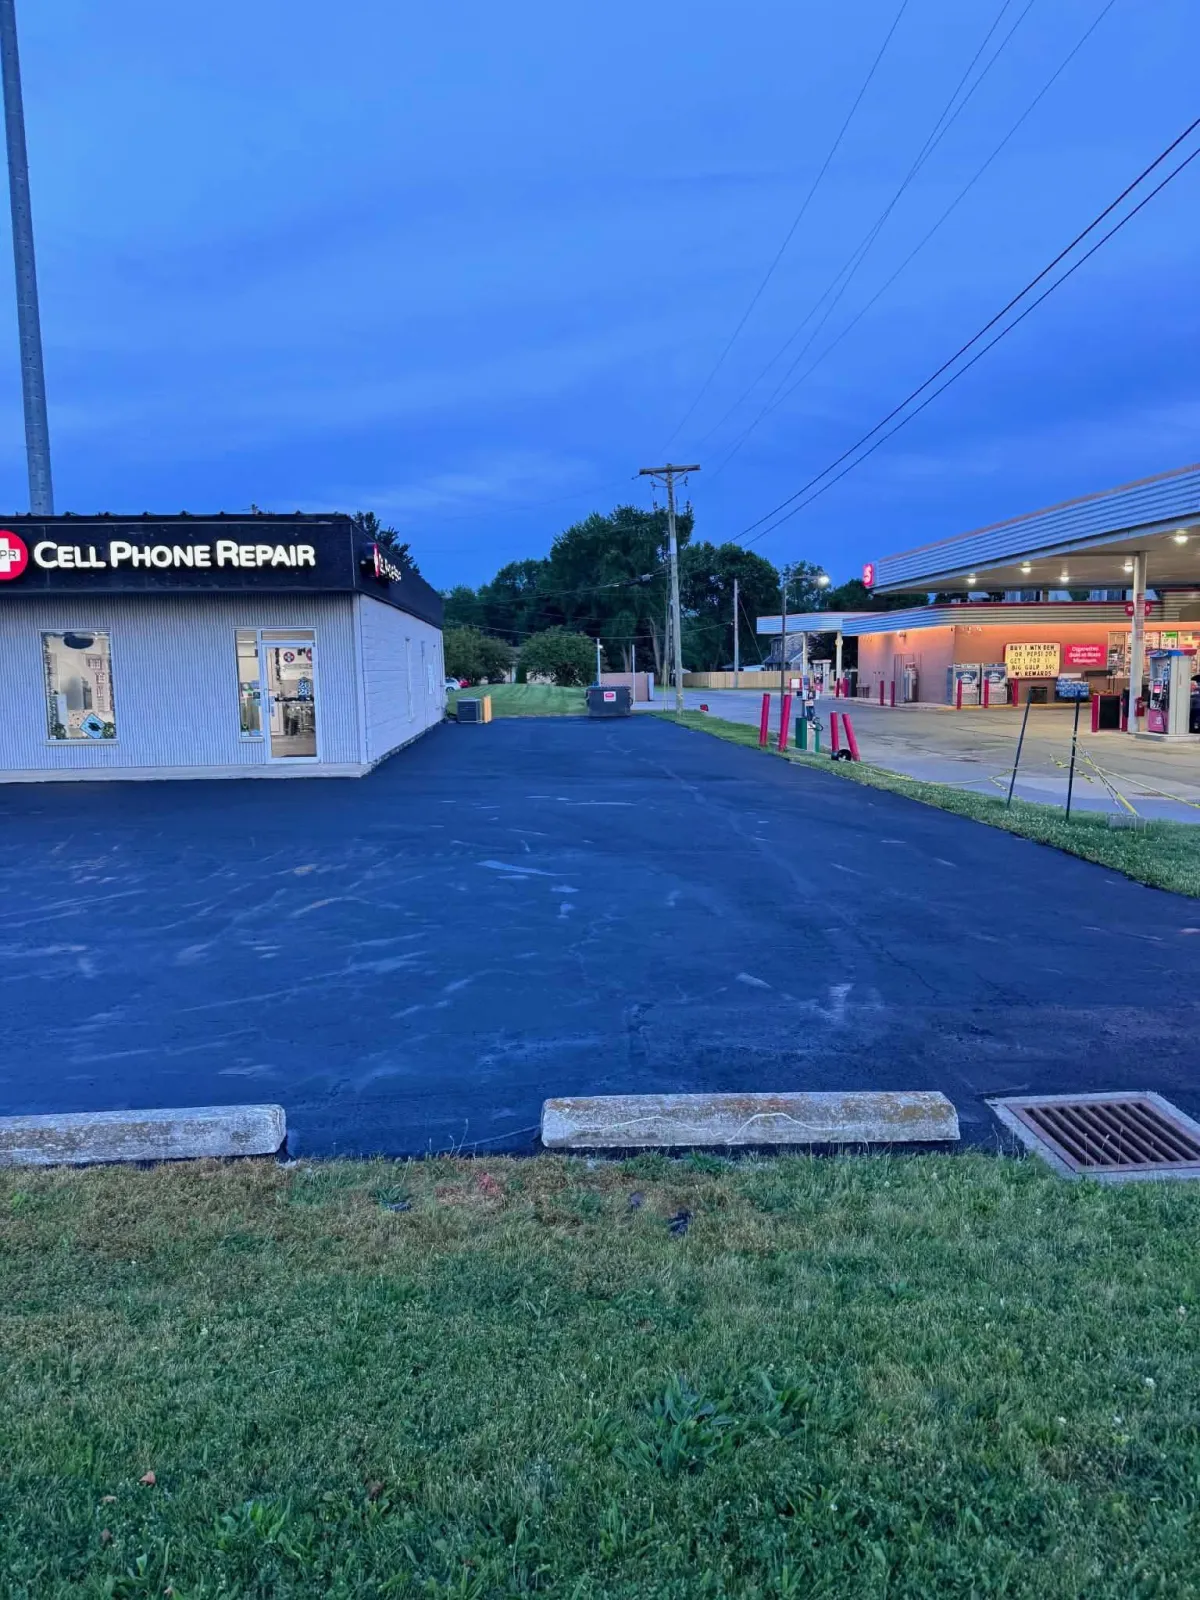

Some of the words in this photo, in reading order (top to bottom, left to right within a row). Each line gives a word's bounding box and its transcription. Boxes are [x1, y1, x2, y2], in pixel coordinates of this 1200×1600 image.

[0, 550, 17, 560] PR
[33, 541, 106, 568] CELL
[109, 540, 212, 567] PHONE
[216, 540, 316, 567] REPAIR
